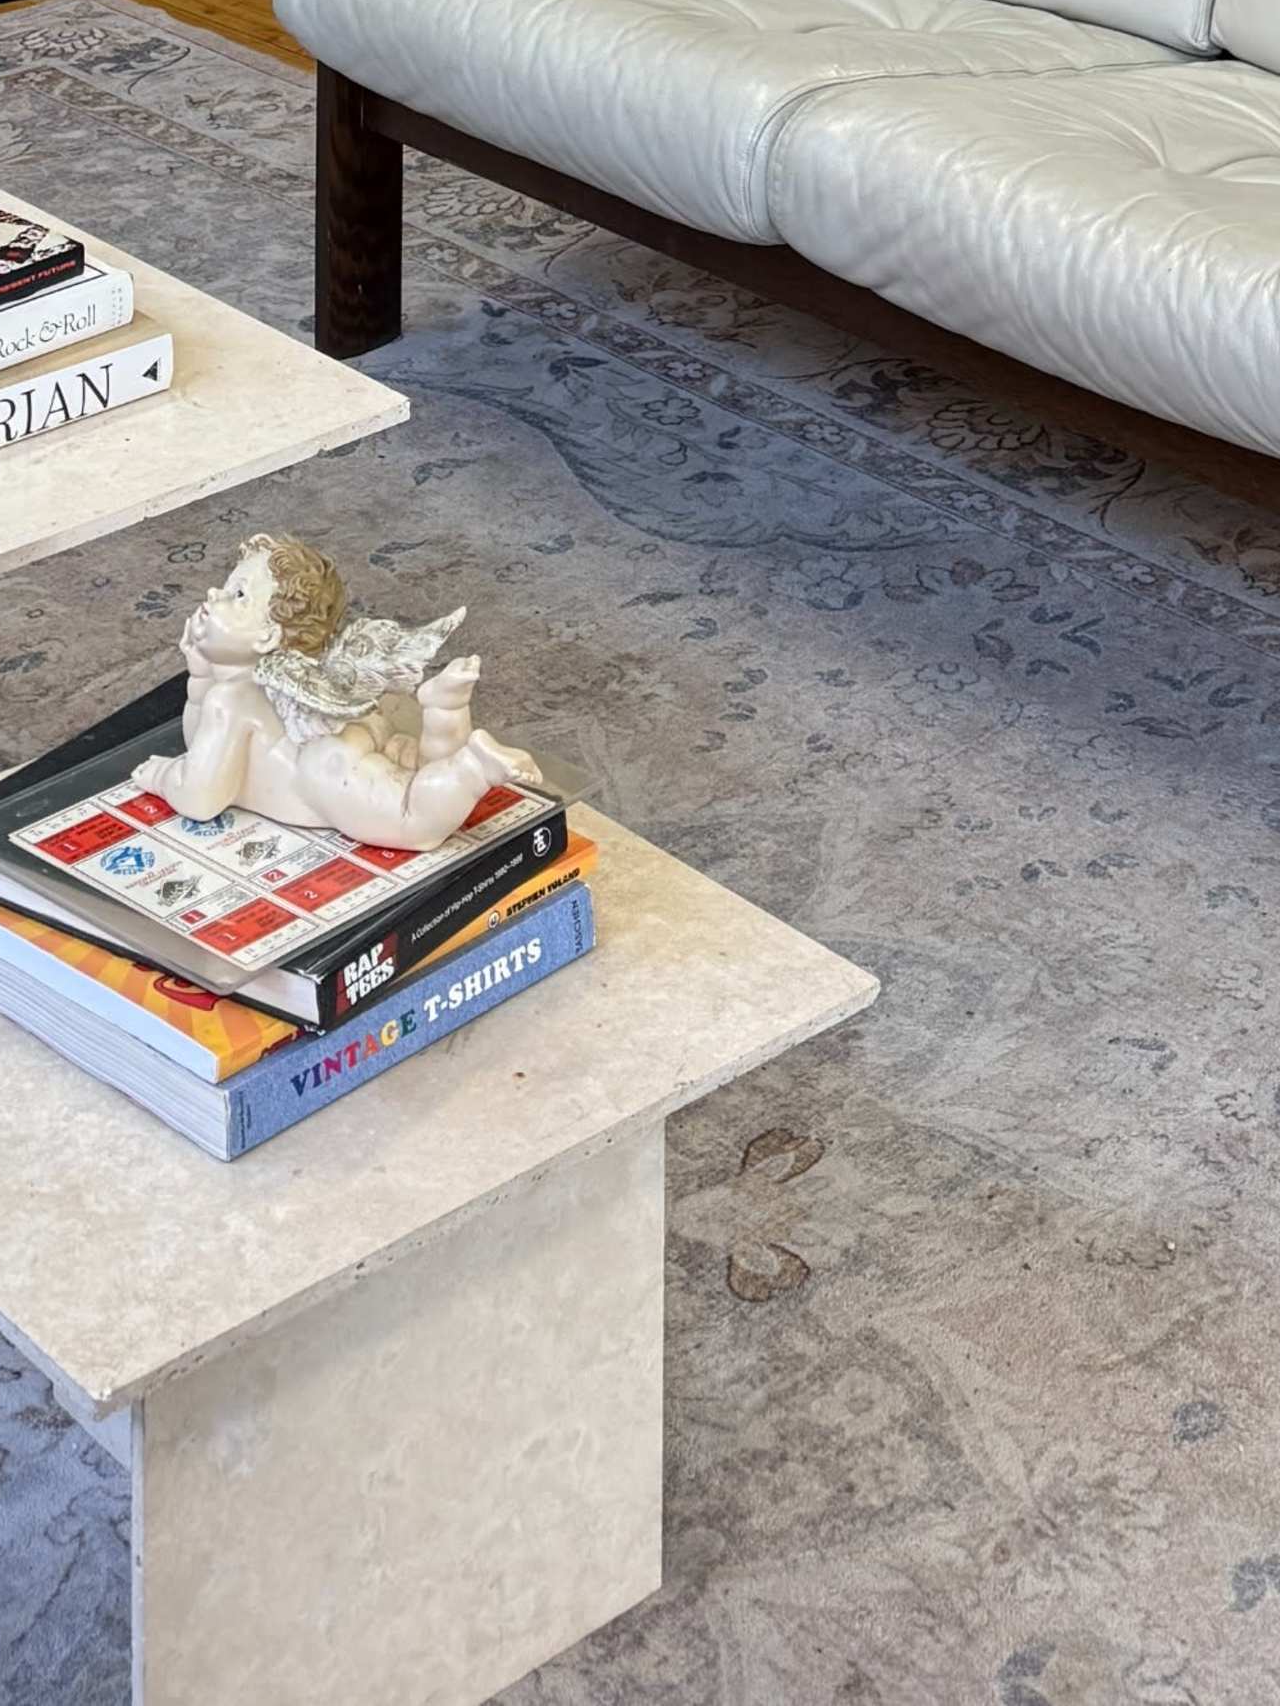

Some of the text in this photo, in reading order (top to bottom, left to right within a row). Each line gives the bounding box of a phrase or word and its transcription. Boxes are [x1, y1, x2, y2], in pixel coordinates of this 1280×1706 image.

[61, 304, 97, 336] Roll
[343, 942, 384, 986] RAP
[289, 938, 542, 1098] VINTAGE T-SHIRTS
